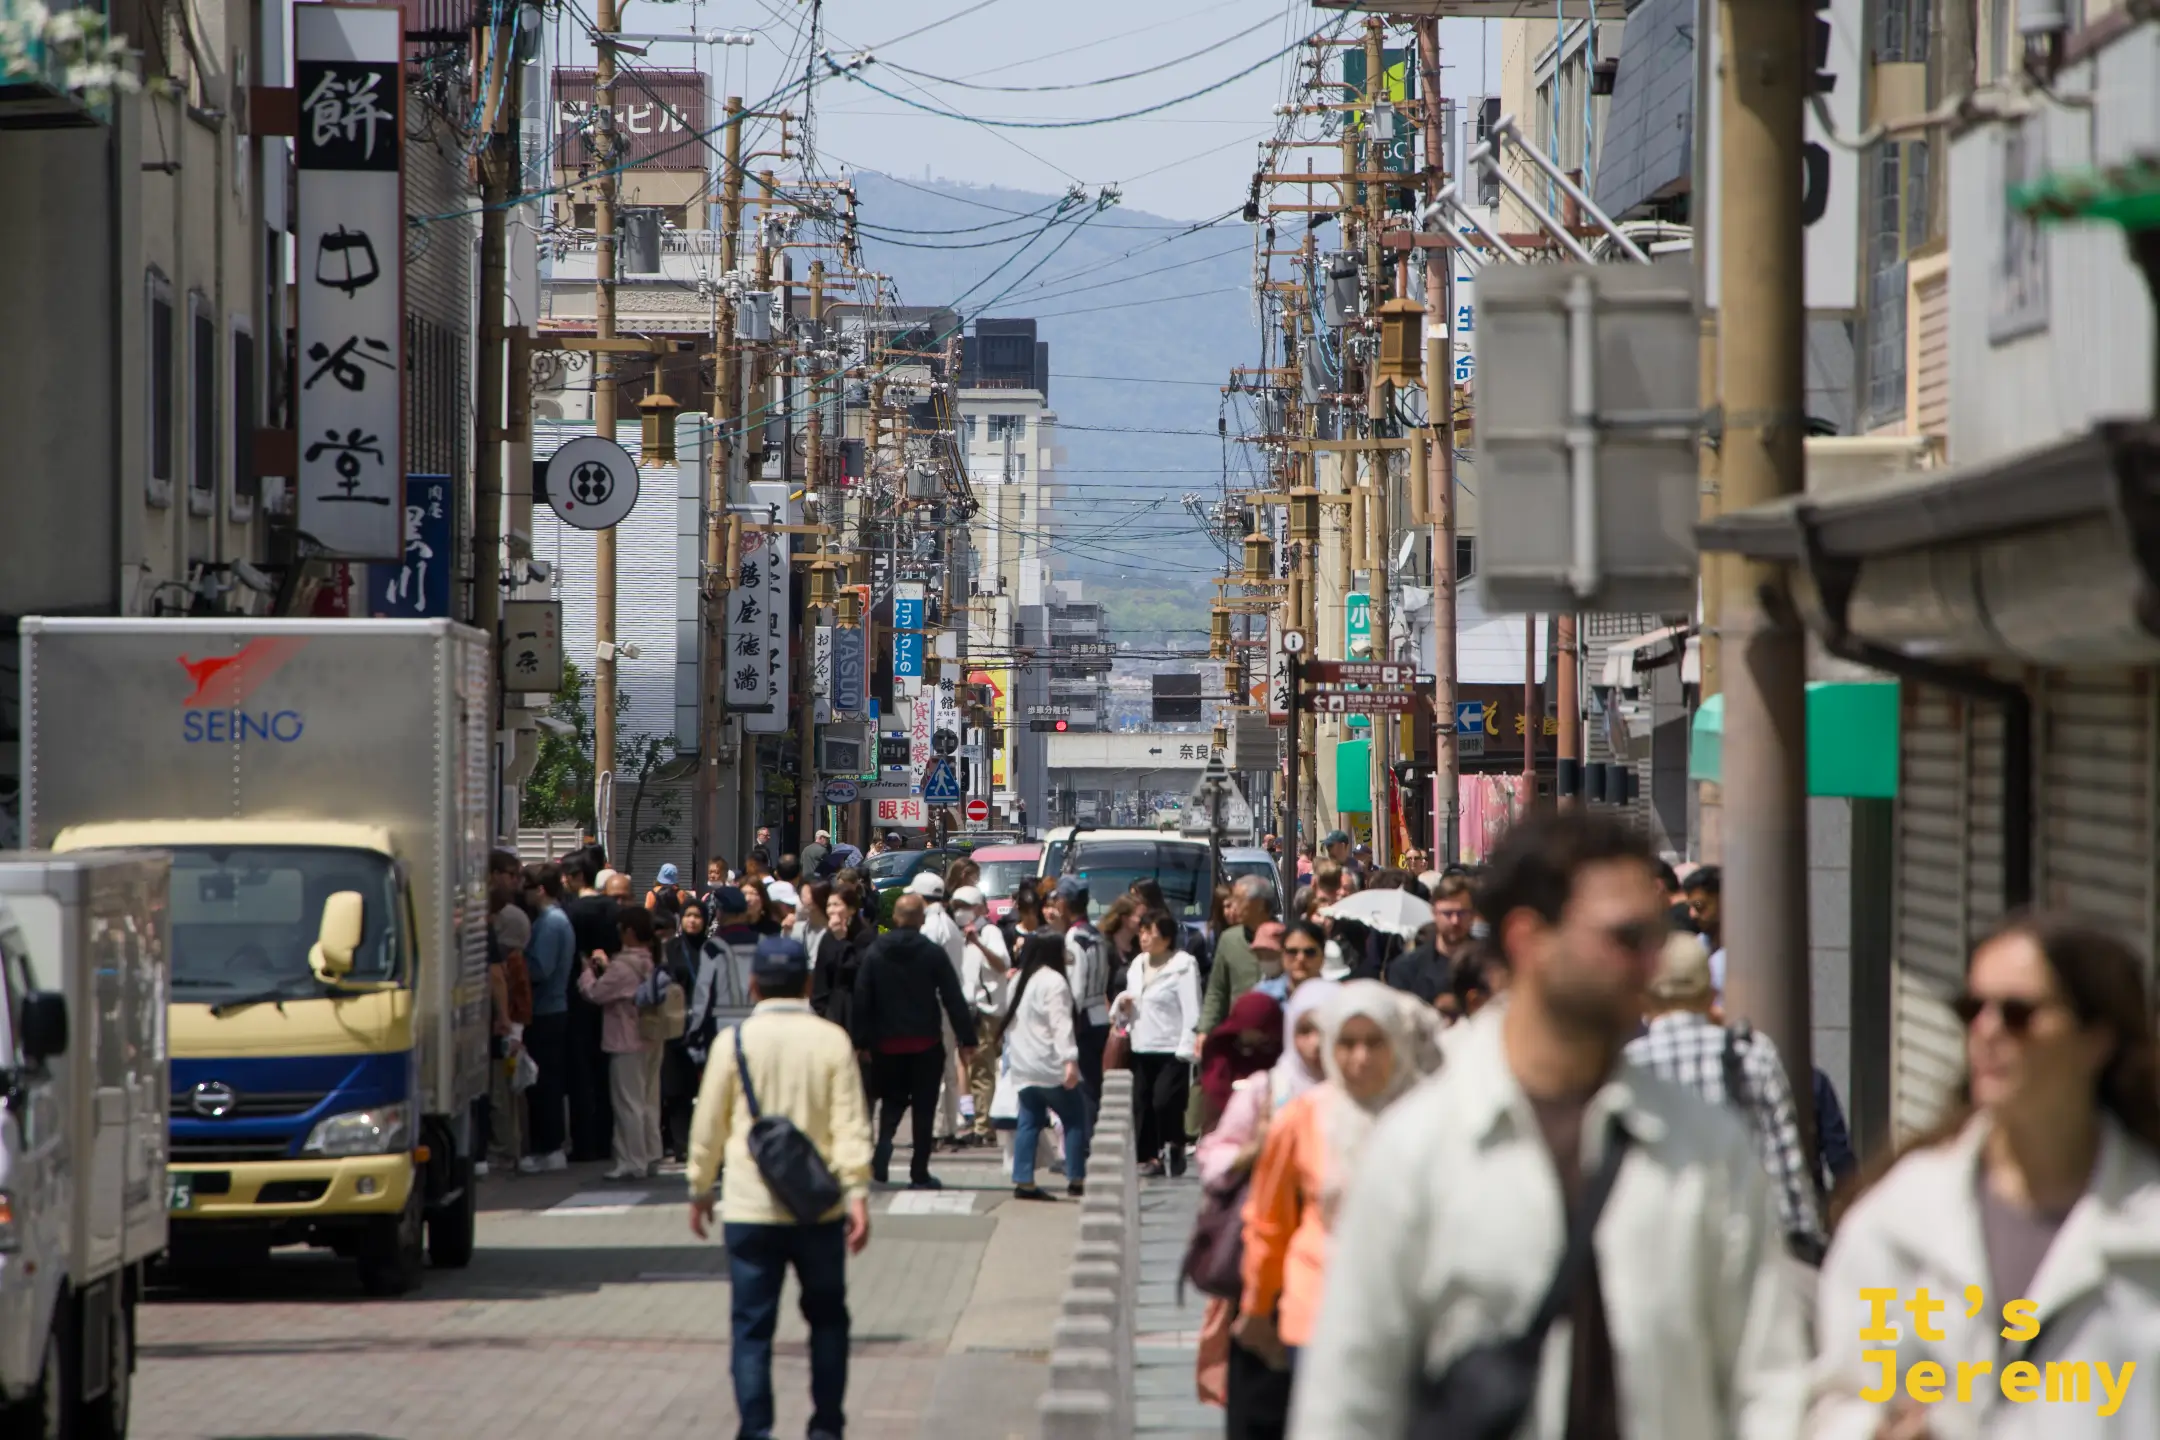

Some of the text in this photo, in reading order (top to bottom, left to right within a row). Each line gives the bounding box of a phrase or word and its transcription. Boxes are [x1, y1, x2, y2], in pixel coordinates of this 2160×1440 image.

[303, 223, 397, 505] 中谷堂
[183, 710, 304, 743] SEINO
[879, 801, 921, 821] 眼科
